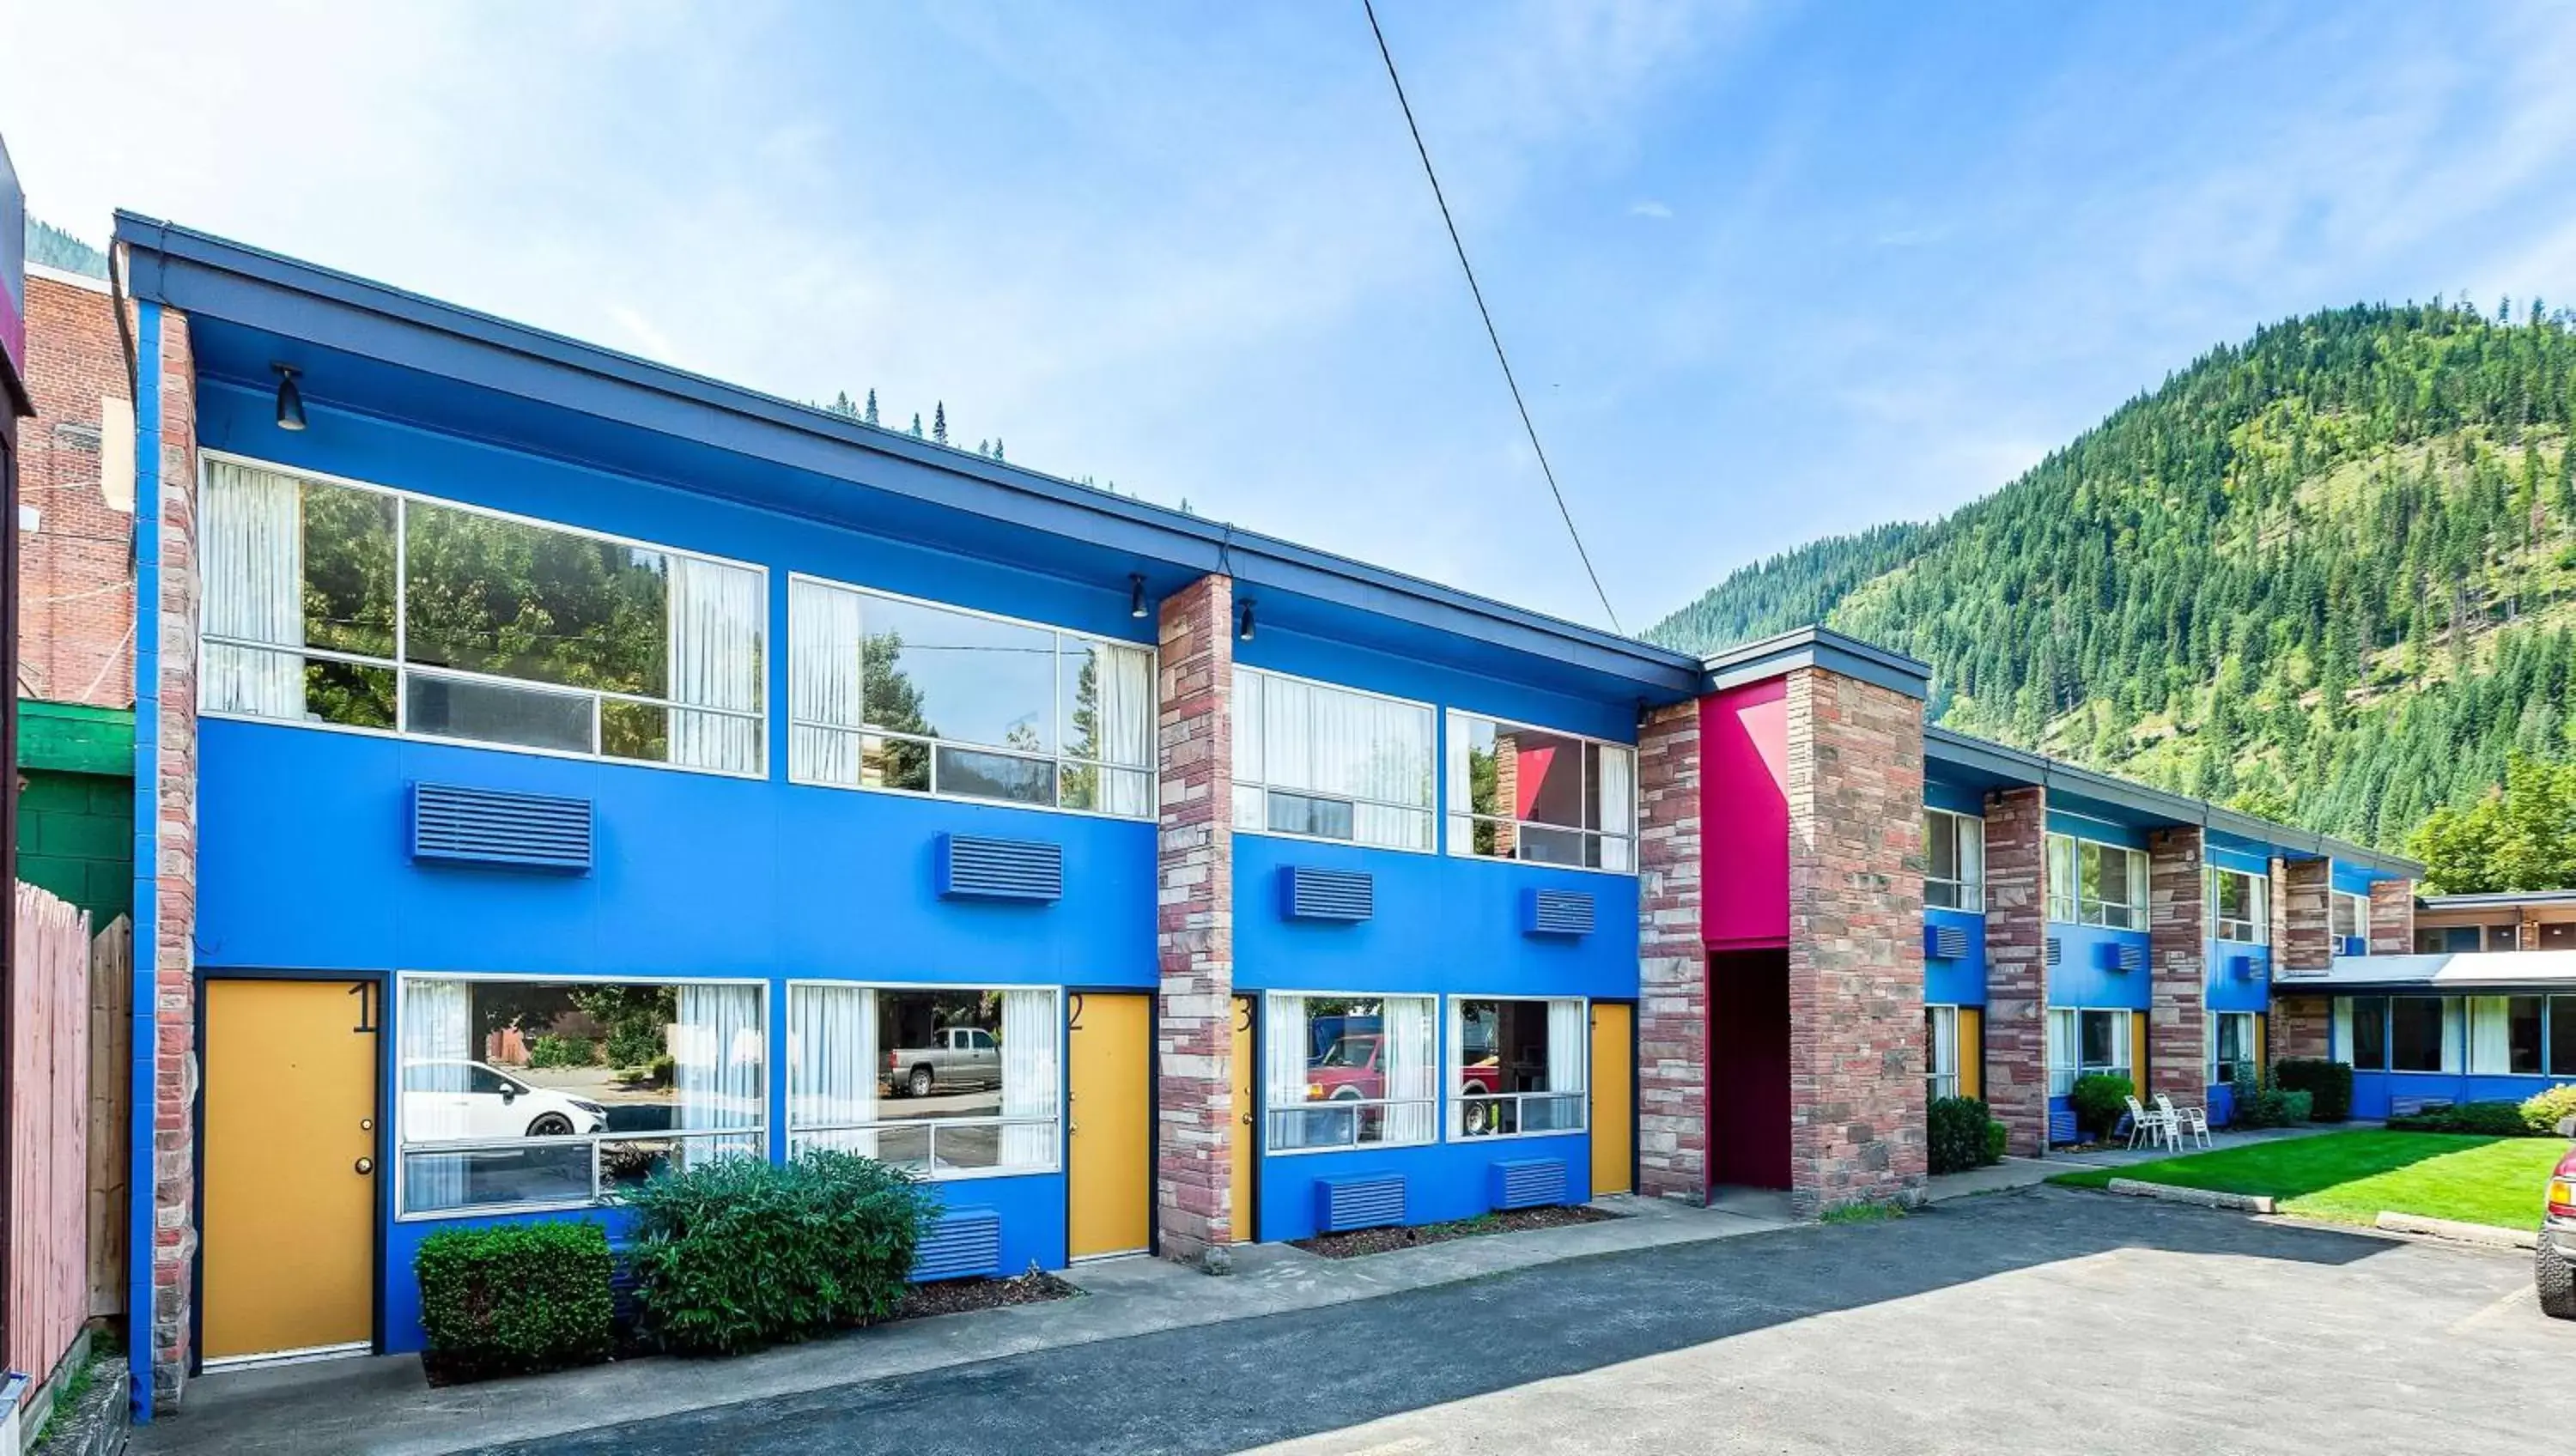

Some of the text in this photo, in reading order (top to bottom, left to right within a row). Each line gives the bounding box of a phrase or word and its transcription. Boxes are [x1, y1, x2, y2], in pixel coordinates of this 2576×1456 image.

[349, 981, 376, 1033] 1
[1069, 992, 1082, 1030] 2
[1236, 996, 1250, 1032] 3
